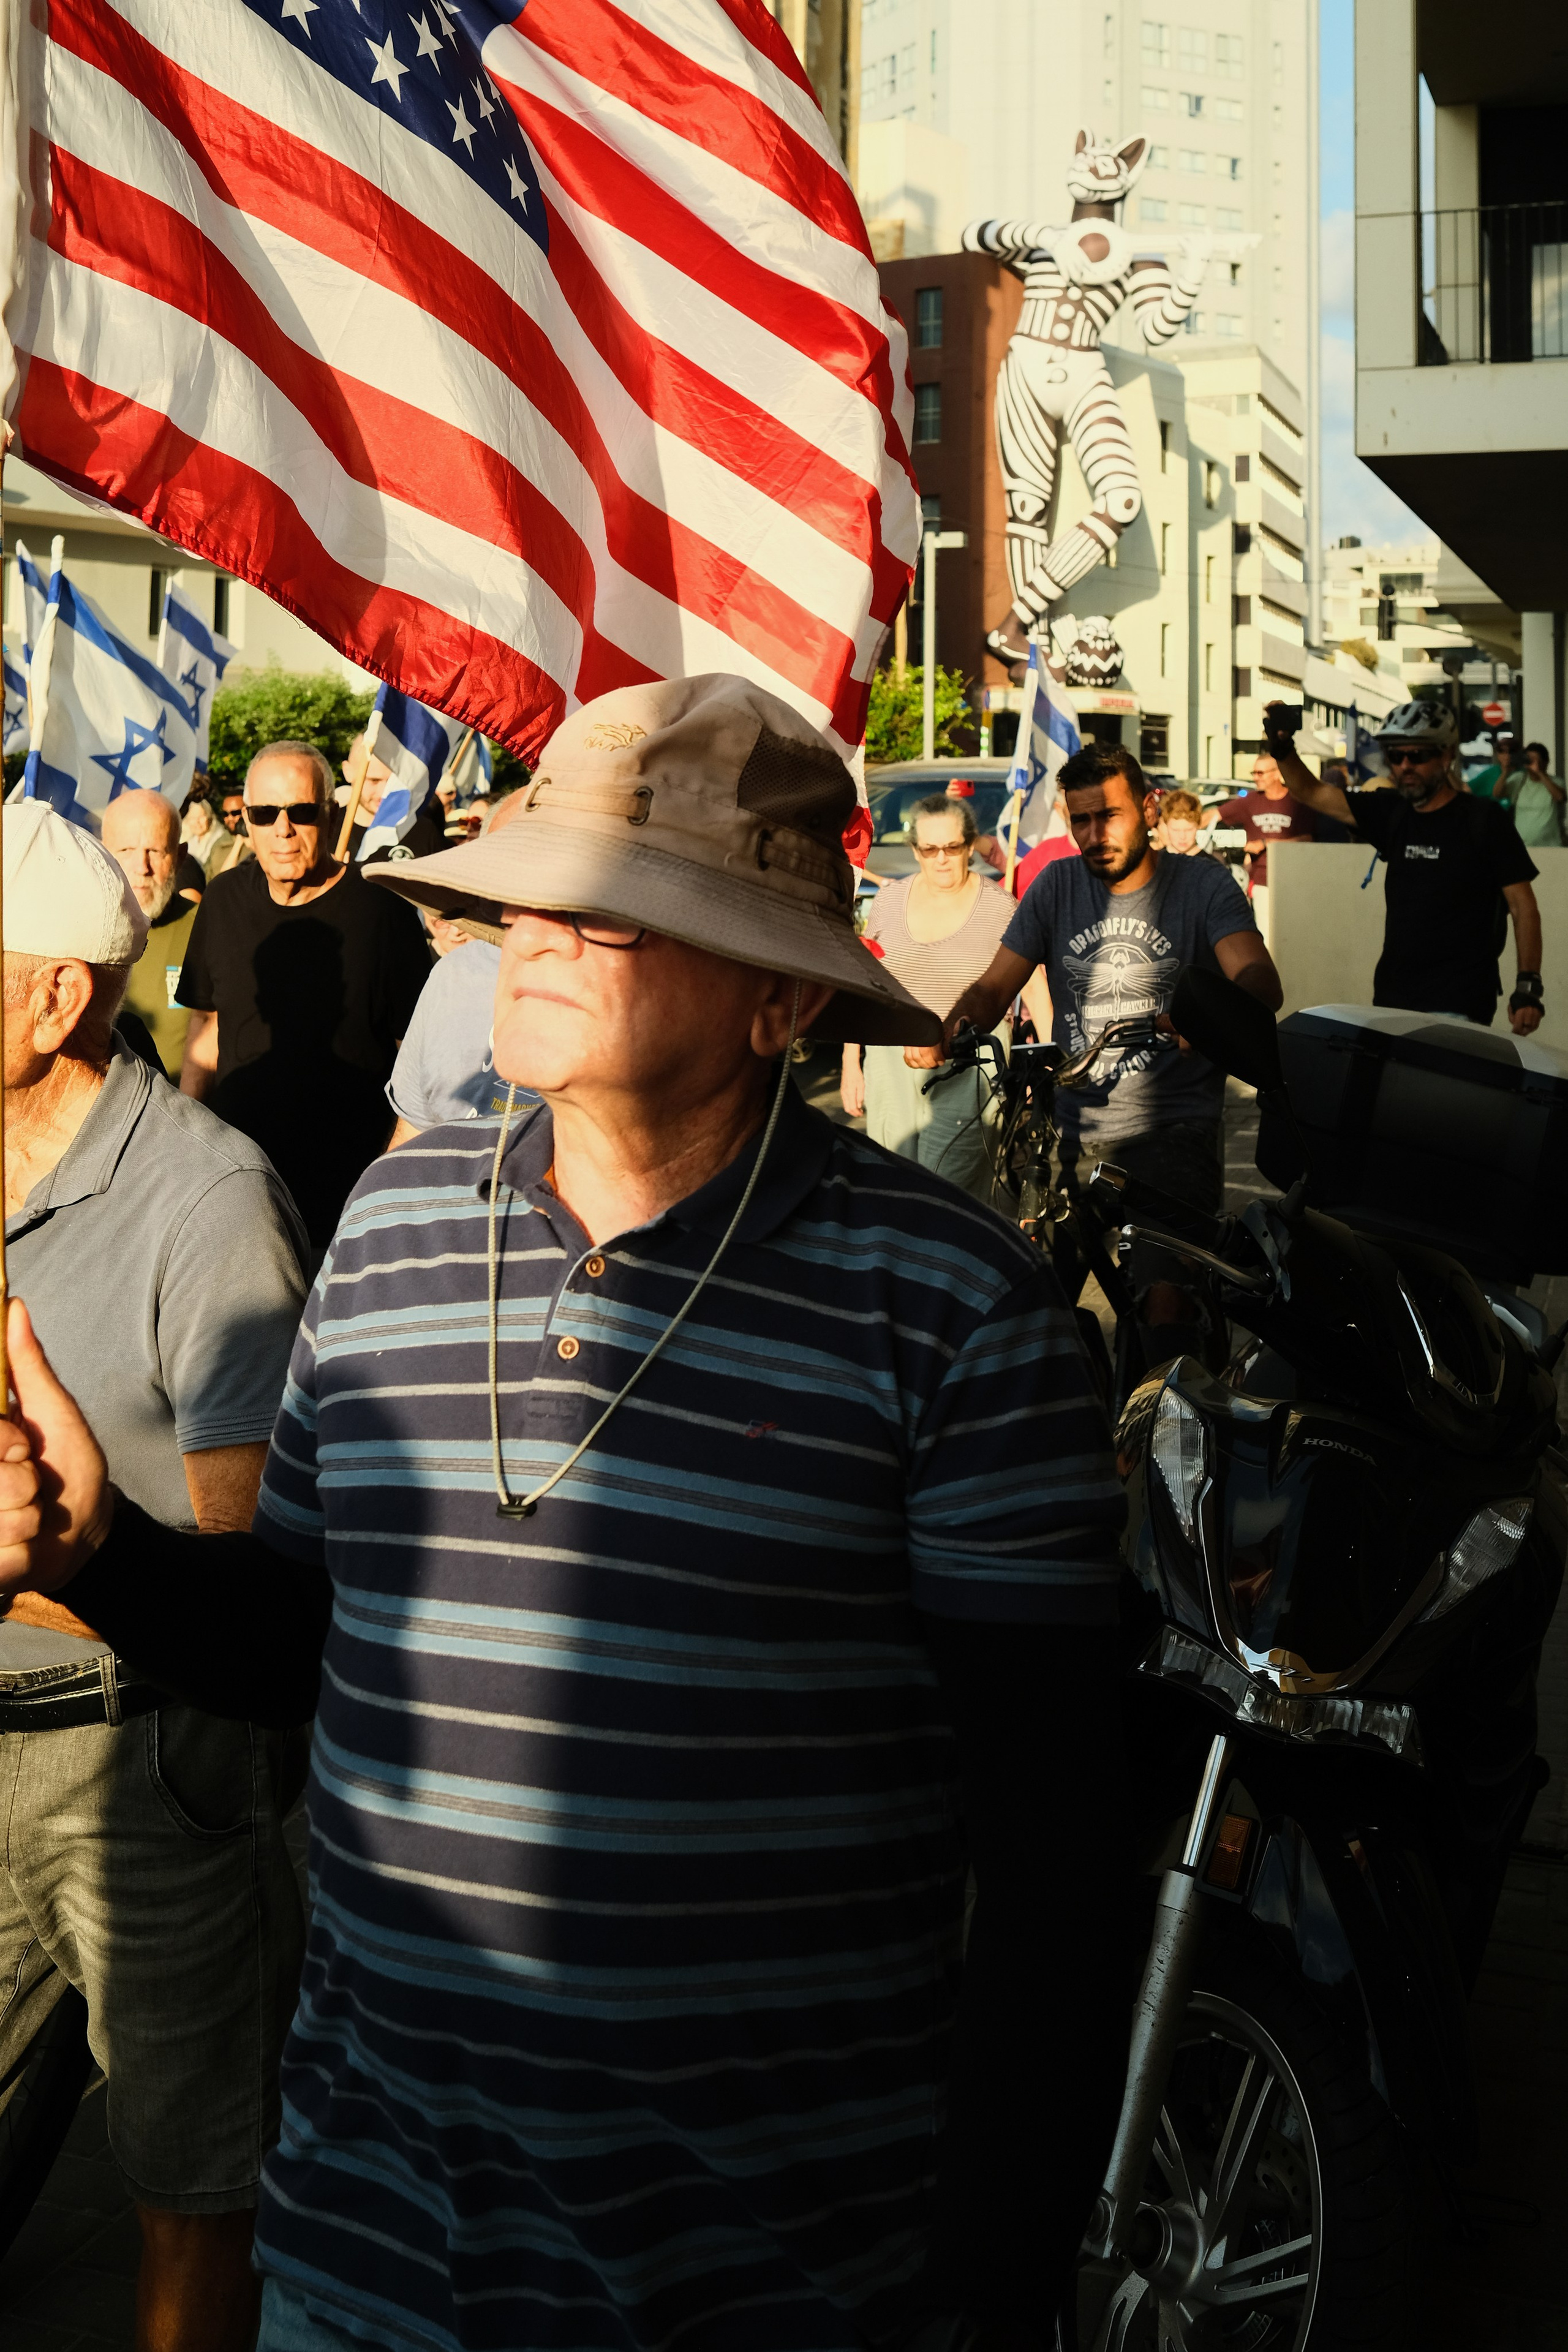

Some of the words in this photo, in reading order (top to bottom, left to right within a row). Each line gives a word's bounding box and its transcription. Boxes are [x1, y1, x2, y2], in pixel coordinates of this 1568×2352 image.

[1068, 917, 1147, 955] DRAGONFLY'S
[1082, 1003, 1115, 1017] MIGRAN
[1302, 1438, 1378, 1467] HONDA
